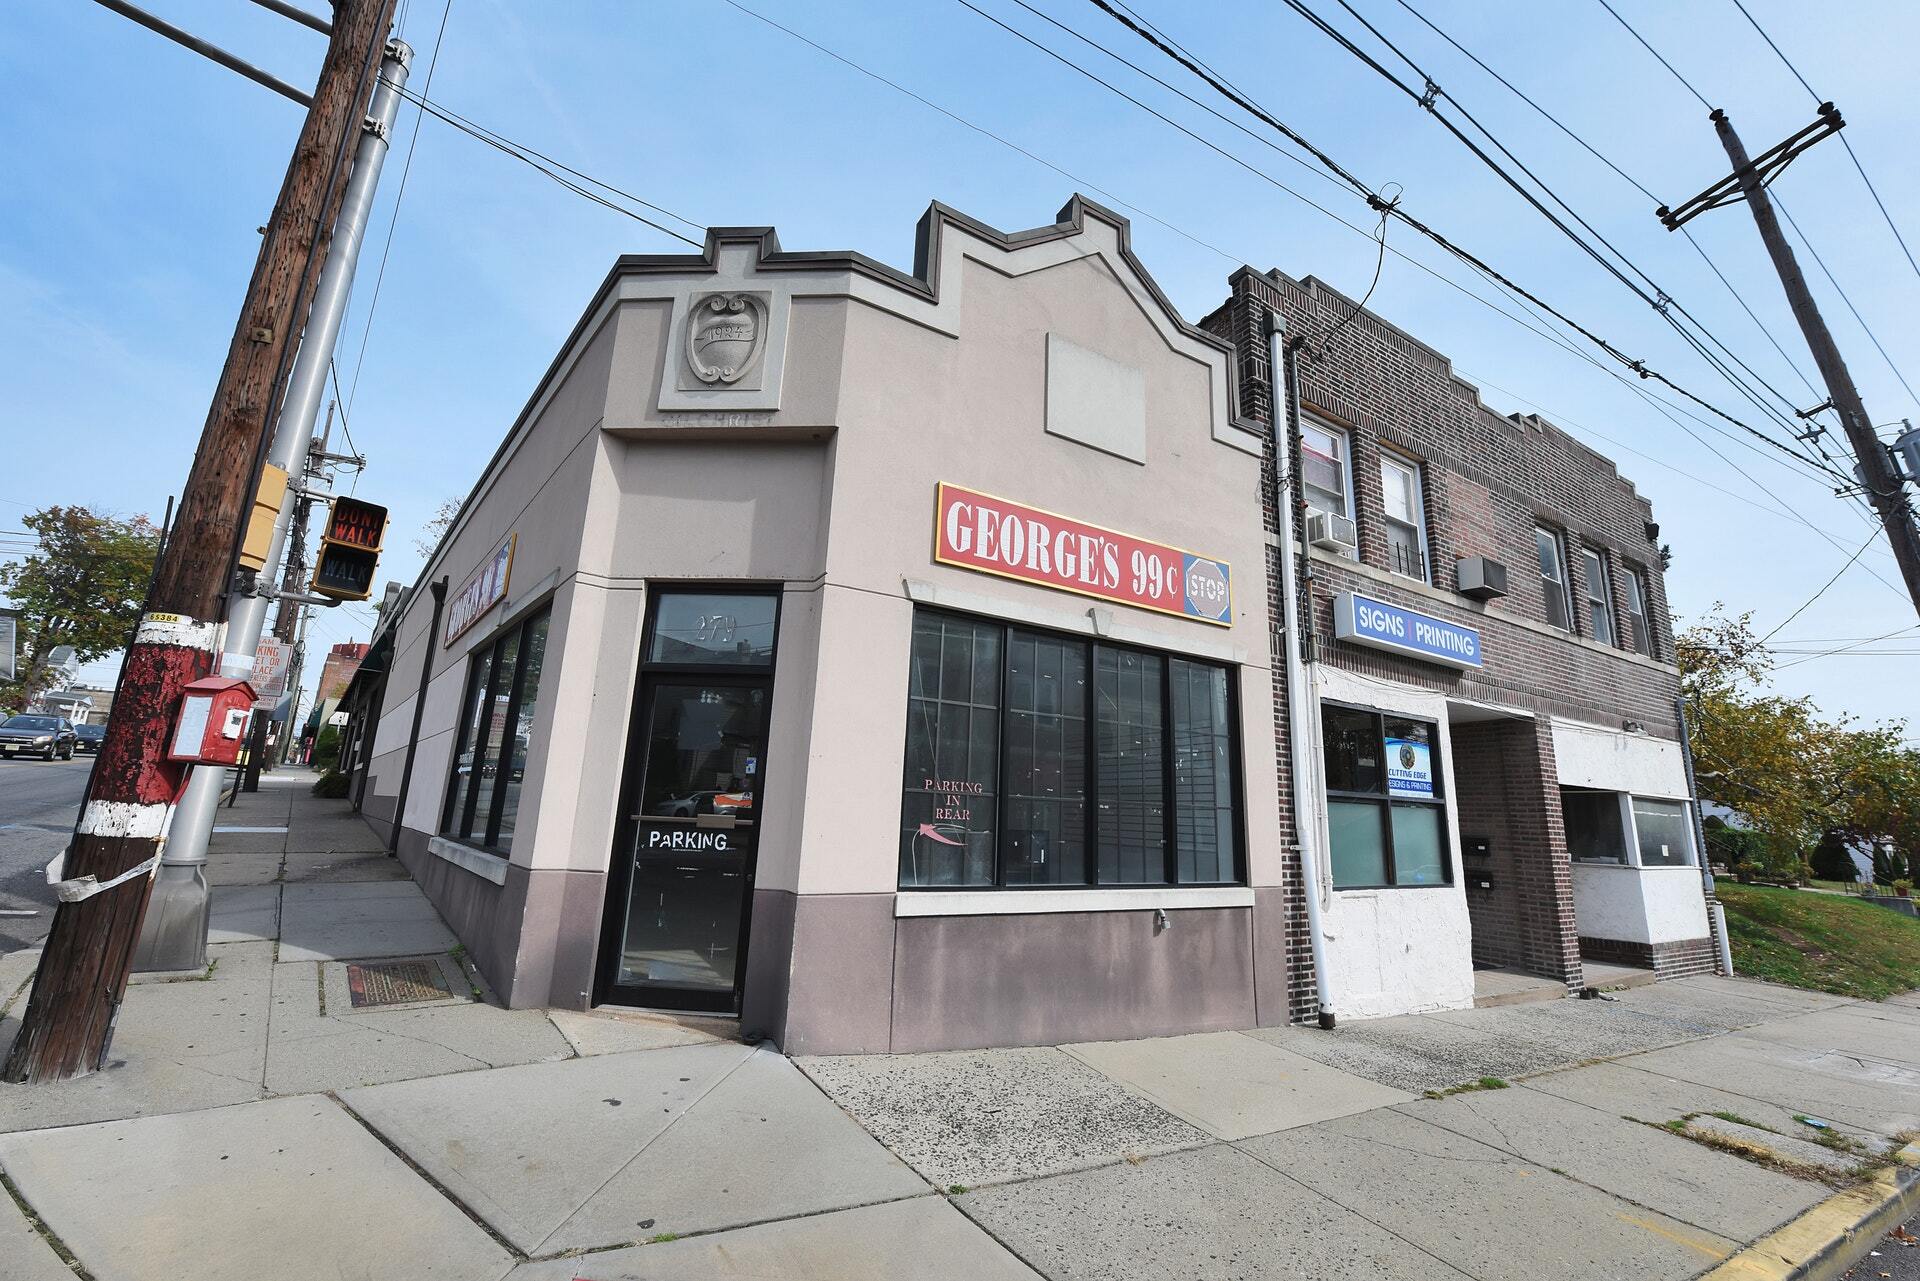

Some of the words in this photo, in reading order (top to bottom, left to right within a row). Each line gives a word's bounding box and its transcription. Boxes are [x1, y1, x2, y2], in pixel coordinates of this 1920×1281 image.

[334, 523, 378, 547] WALK
[946, 501, 1120, 589] GEORGE'S
[325, 560, 367, 583] WALK
[1191, 574, 1225, 602] STOP
[696, 615, 737, 642] 279
[1359, 605, 1405, 638] SIGNS
[1415, 621, 1475, 657] PRINTING
[256, 646, 280, 656] KING
[1389, 769, 1412, 778] CUTTING
[1413, 771, 1427, 780] EDGE
[924, 779, 983, 794] PARKING
[1411, 781, 1432, 790] PRINTING
[946, 794, 961, 806] IN
[935, 808, 970, 821] REAR
[649, 831, 728, 851] PARKING
